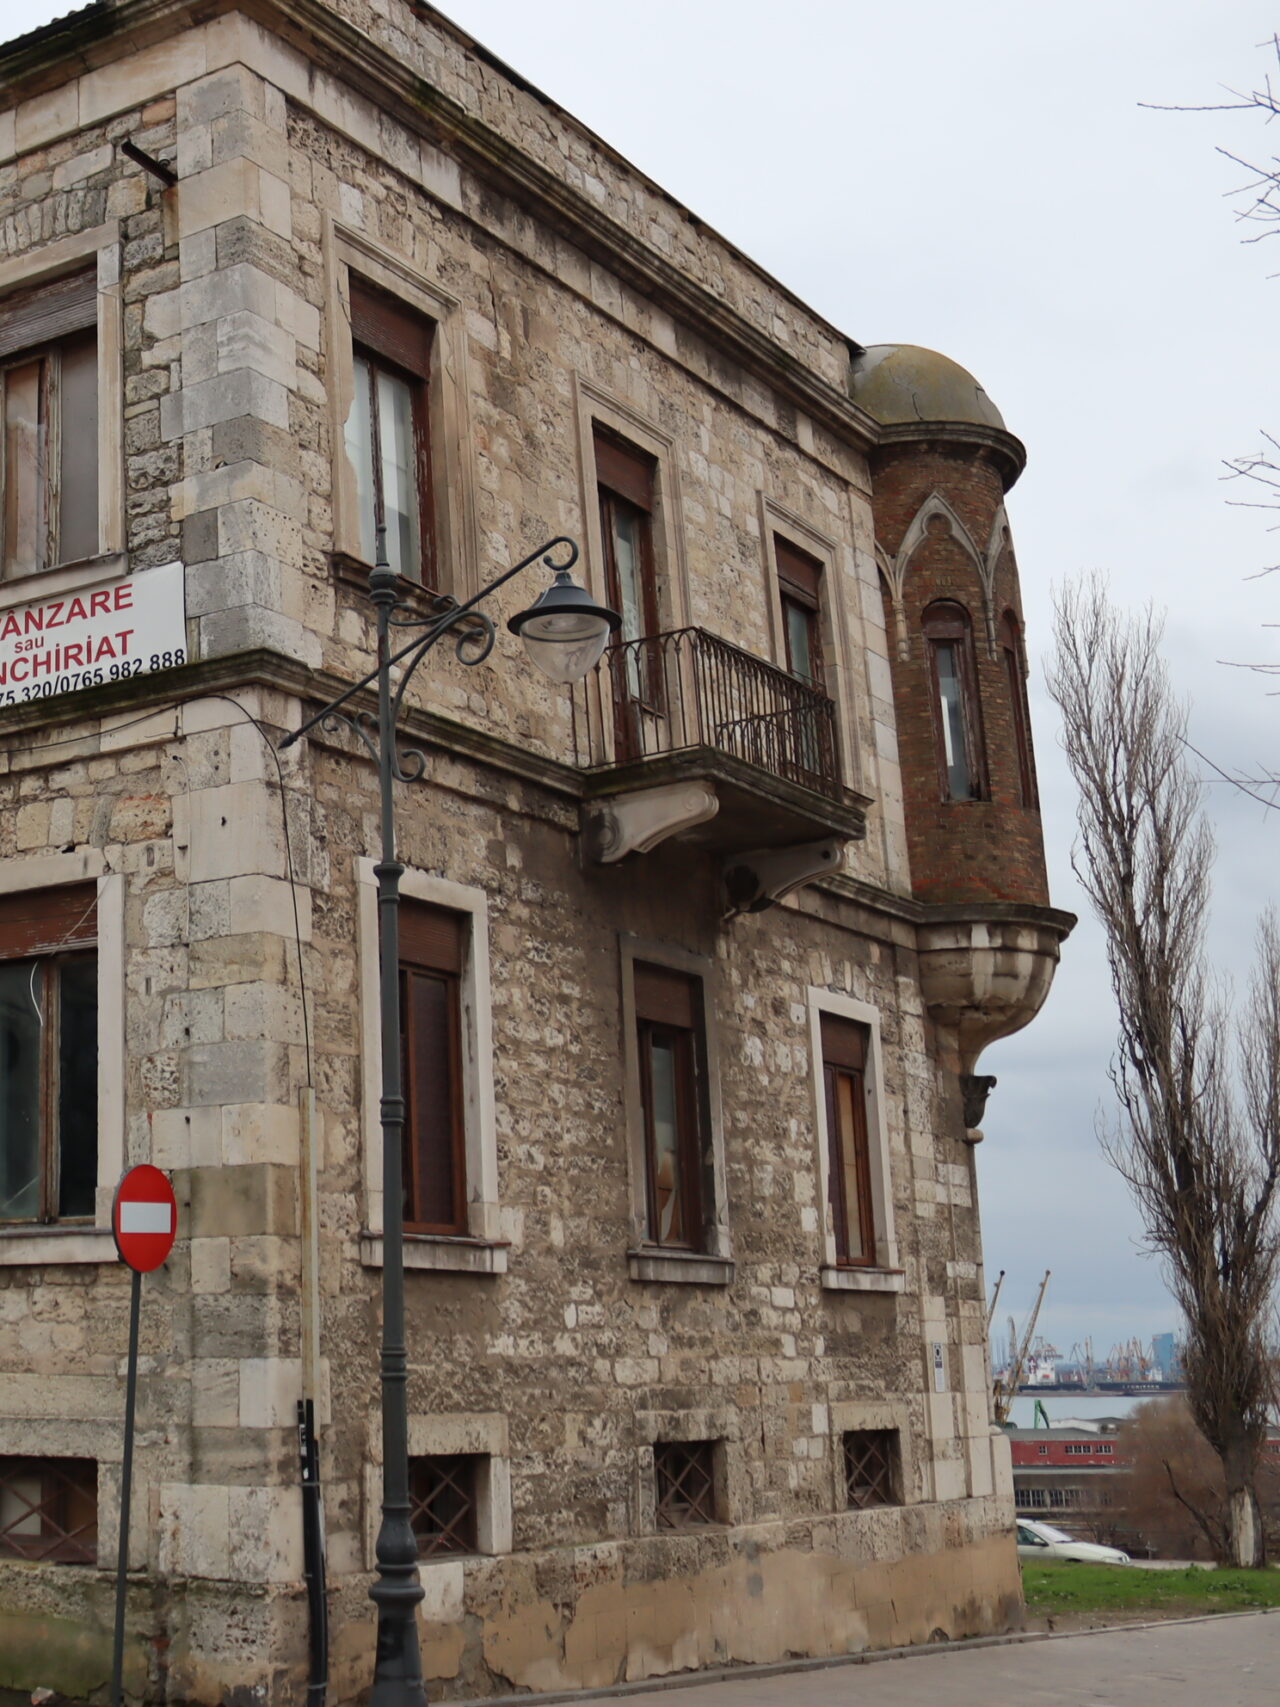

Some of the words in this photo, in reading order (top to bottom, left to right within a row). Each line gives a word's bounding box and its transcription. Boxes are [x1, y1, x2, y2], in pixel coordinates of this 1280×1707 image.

[14, 635, 45, 654] sau
[109, 658, 143, 682] 982
[149, 648, 185, 672] 888
